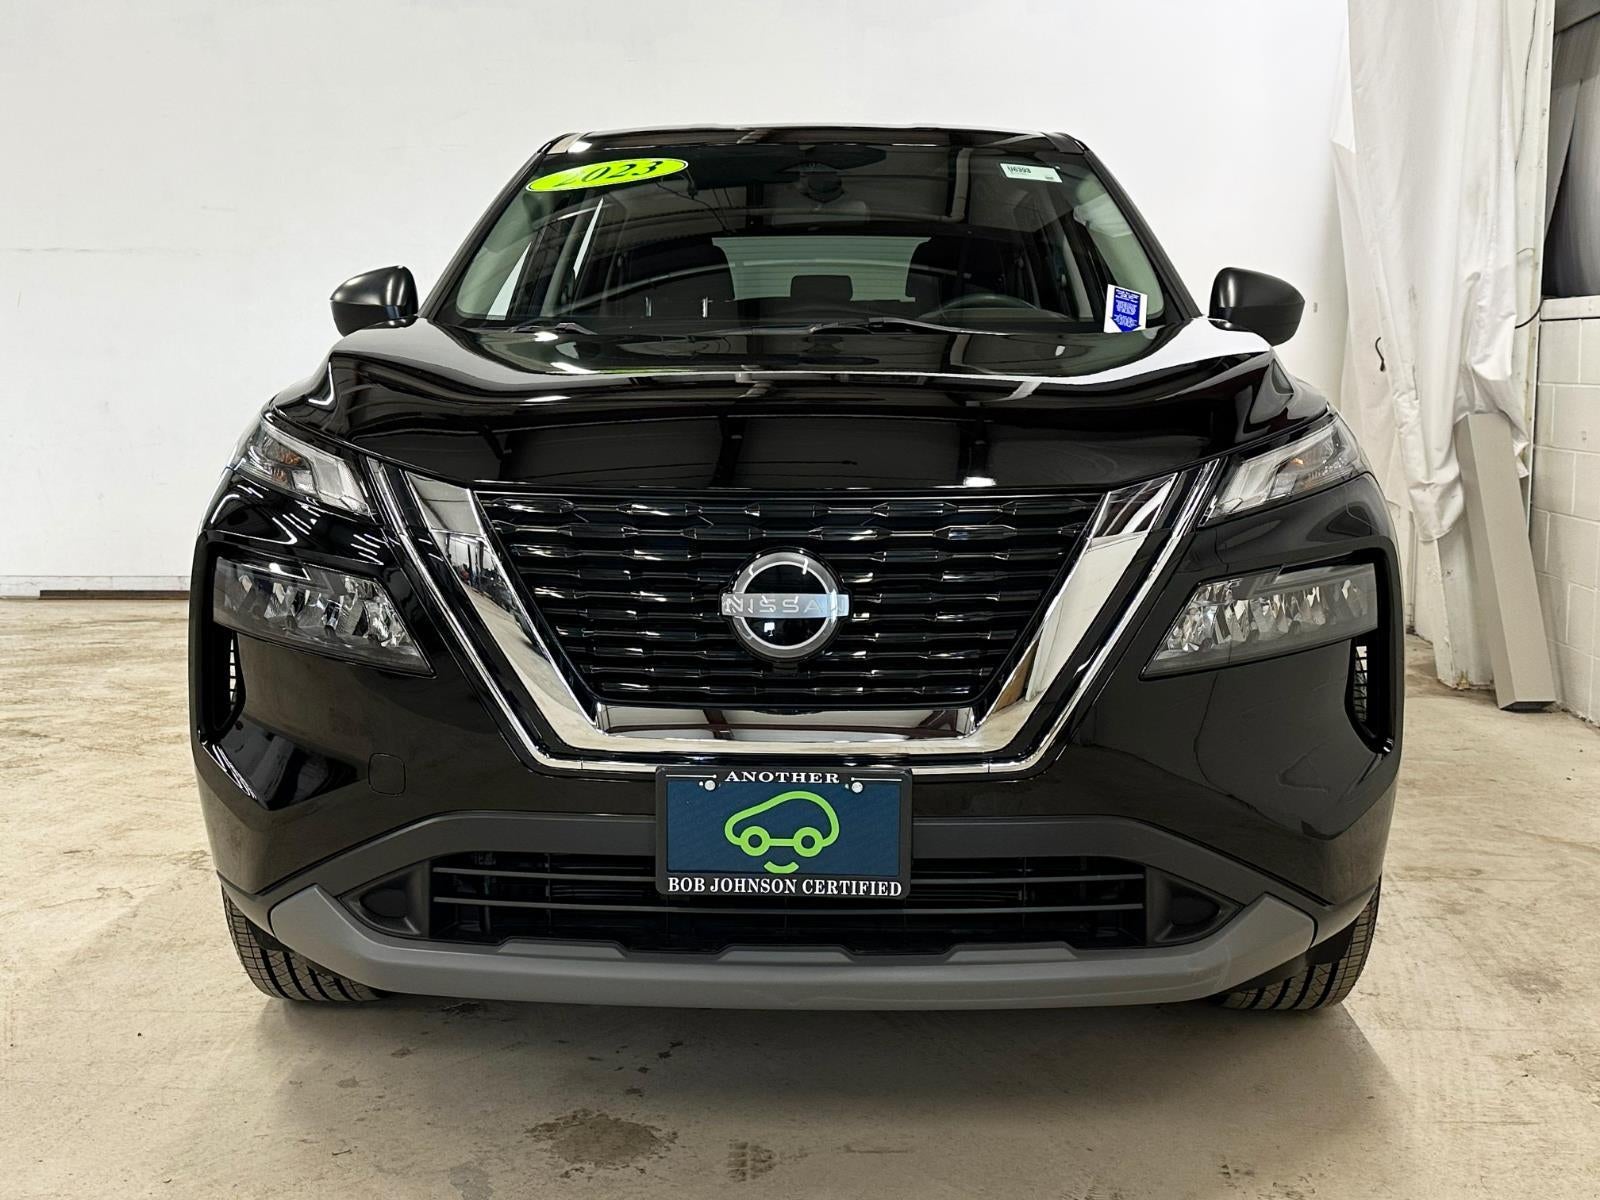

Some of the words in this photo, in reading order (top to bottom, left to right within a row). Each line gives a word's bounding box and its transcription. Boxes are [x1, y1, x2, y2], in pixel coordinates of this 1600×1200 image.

[724, 771, 840, 784] ANOTHER
[667, 877, 706, 893] BOB
[710, 877, 797, 894] JOHNSON
[802, 879, 902, 897] CERTIFIED
